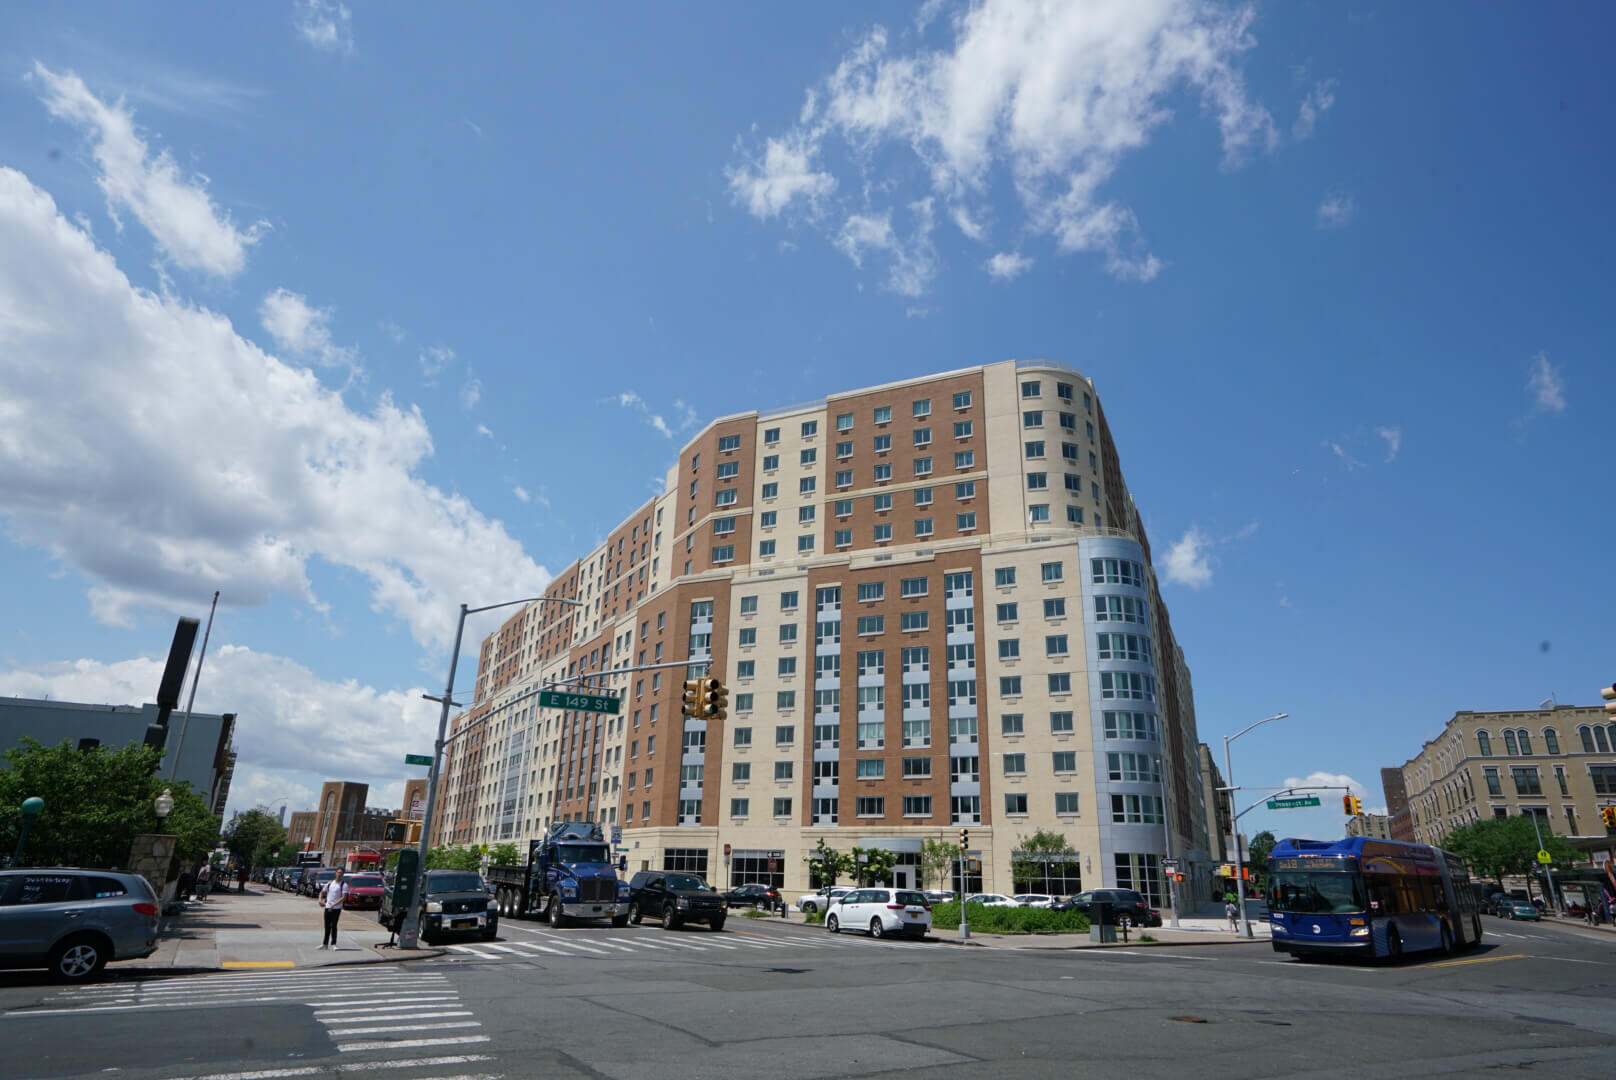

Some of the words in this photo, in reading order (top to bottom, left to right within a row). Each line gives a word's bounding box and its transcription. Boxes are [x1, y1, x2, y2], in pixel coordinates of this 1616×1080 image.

[551, 695, 559, 704] E
[566, 696, 588, 707] 149
[595, 700, 608, 710] St
